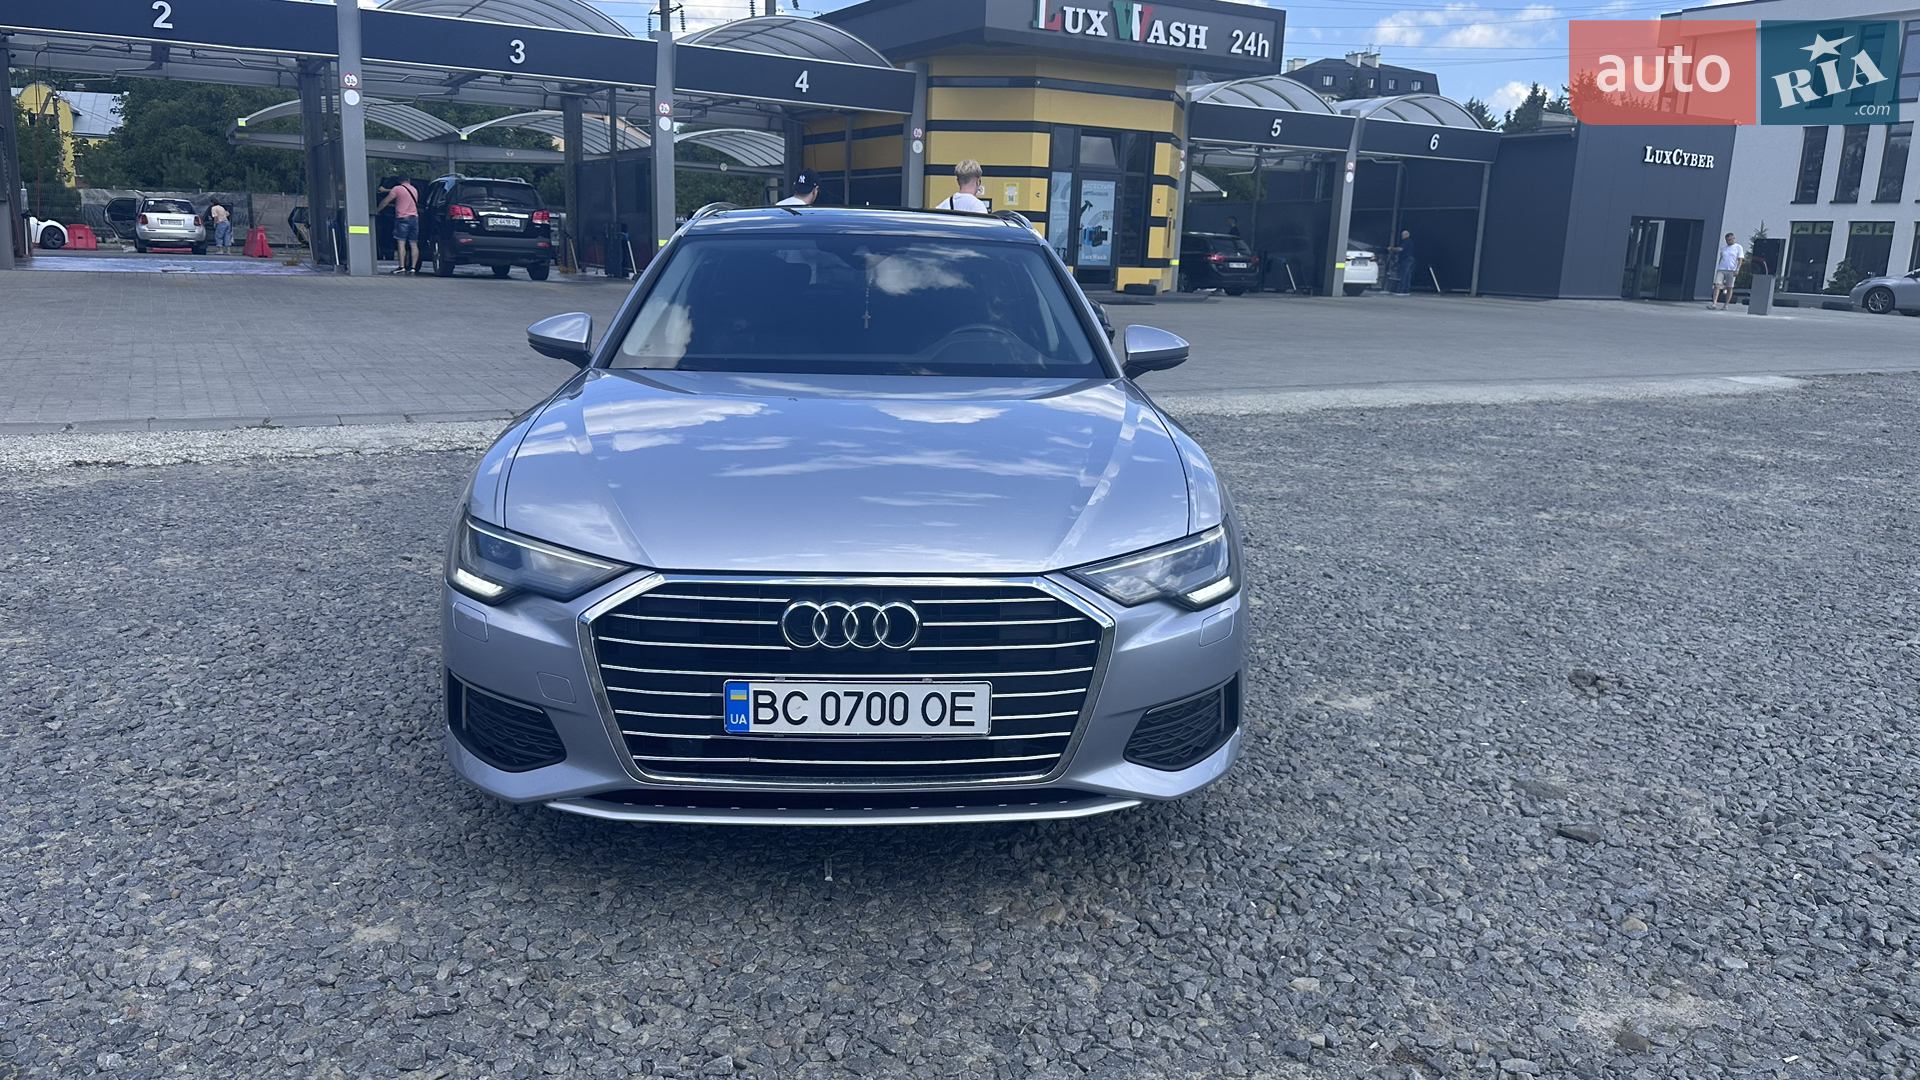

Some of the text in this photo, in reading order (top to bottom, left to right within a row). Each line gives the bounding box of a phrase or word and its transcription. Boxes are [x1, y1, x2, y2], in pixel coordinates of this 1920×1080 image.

[152, 0, 173, 29] 2
[509, 39, 526, 64] 3
[1230, 29, 1270, 58] 24h
[794, 70, 810, 93] 4
[1271, 118, 1283, 137] 5
[1430, 133, 1440, 151] 6
[730, 714, 747, 725] UA
[752, 690, 976, 727] BC 0700 OE
